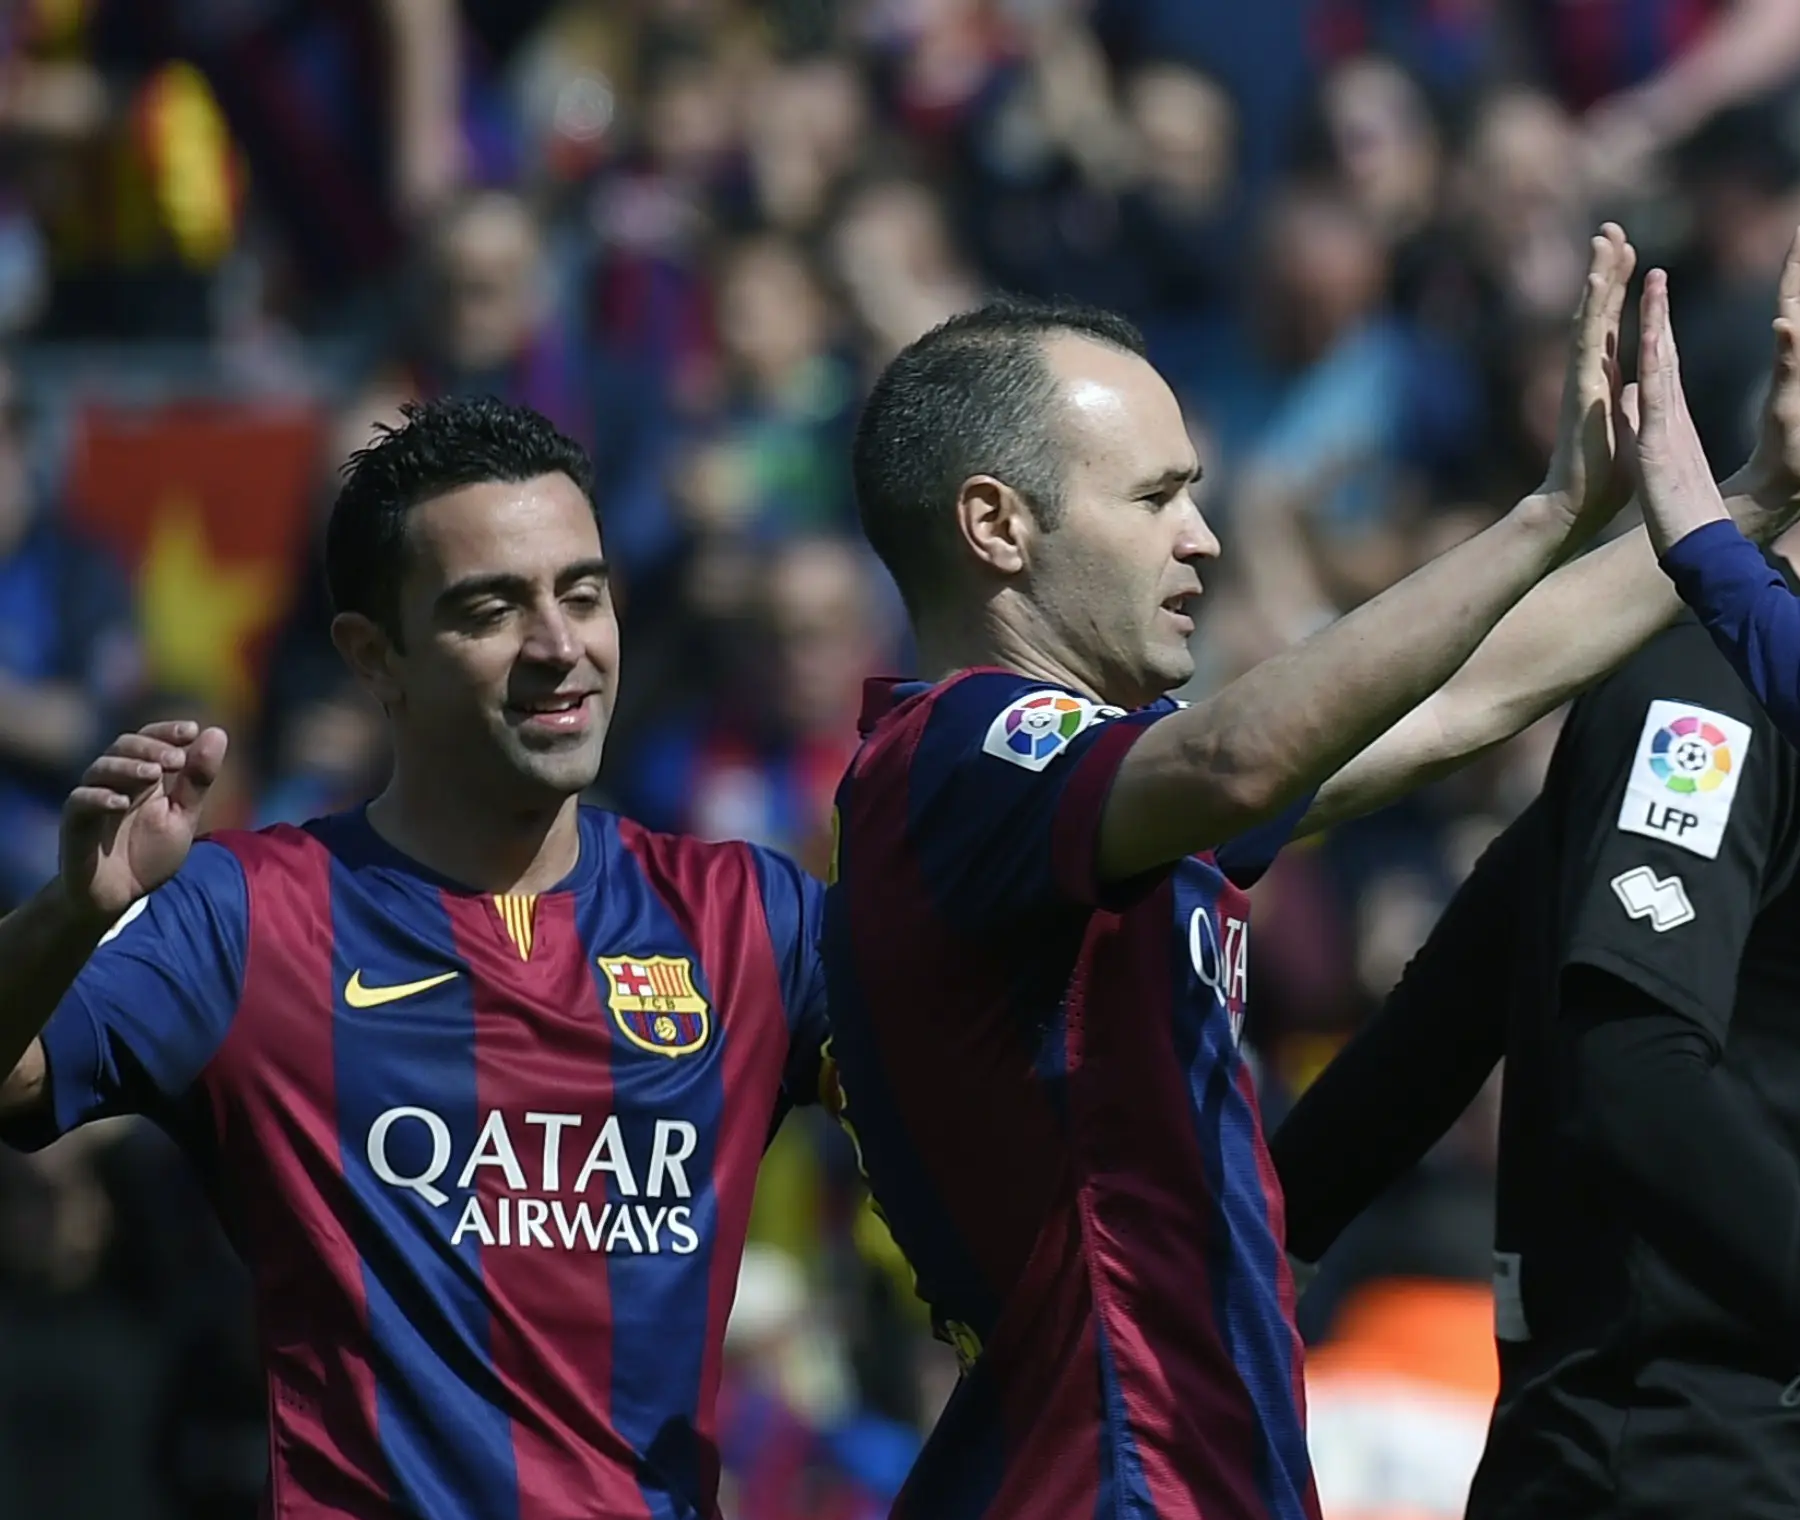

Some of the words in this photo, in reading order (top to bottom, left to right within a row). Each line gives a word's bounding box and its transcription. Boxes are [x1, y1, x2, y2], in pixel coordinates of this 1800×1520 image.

[1645, 801, 1699, 837] LFP
[367, 1106, 698, 1207] QATAR
[451, 1196, 699, 1254] AIRWAYS
